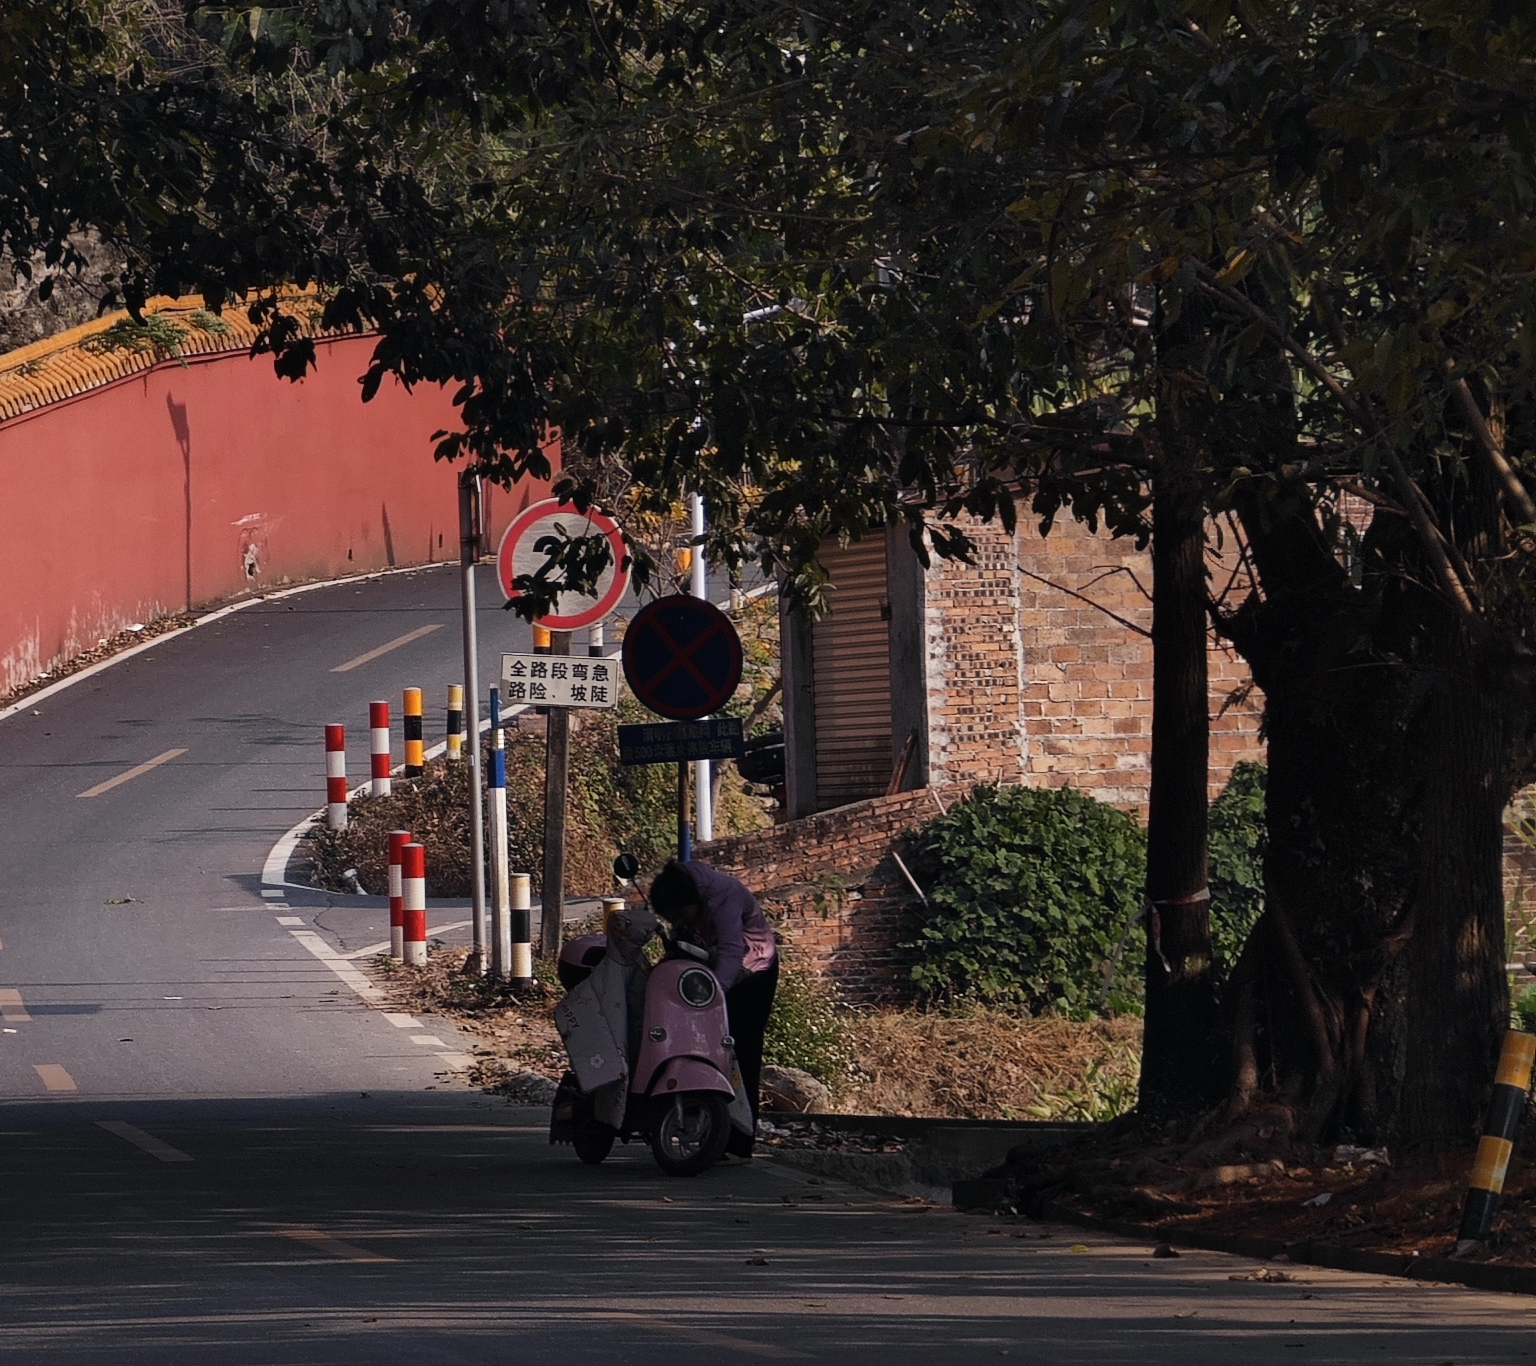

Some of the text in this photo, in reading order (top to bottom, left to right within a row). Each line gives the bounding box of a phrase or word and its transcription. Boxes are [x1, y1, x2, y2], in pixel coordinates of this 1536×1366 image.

[510, 660, 609, 682] 全路段弯急
[509, 681, 608, 702] 路险、坡陡
